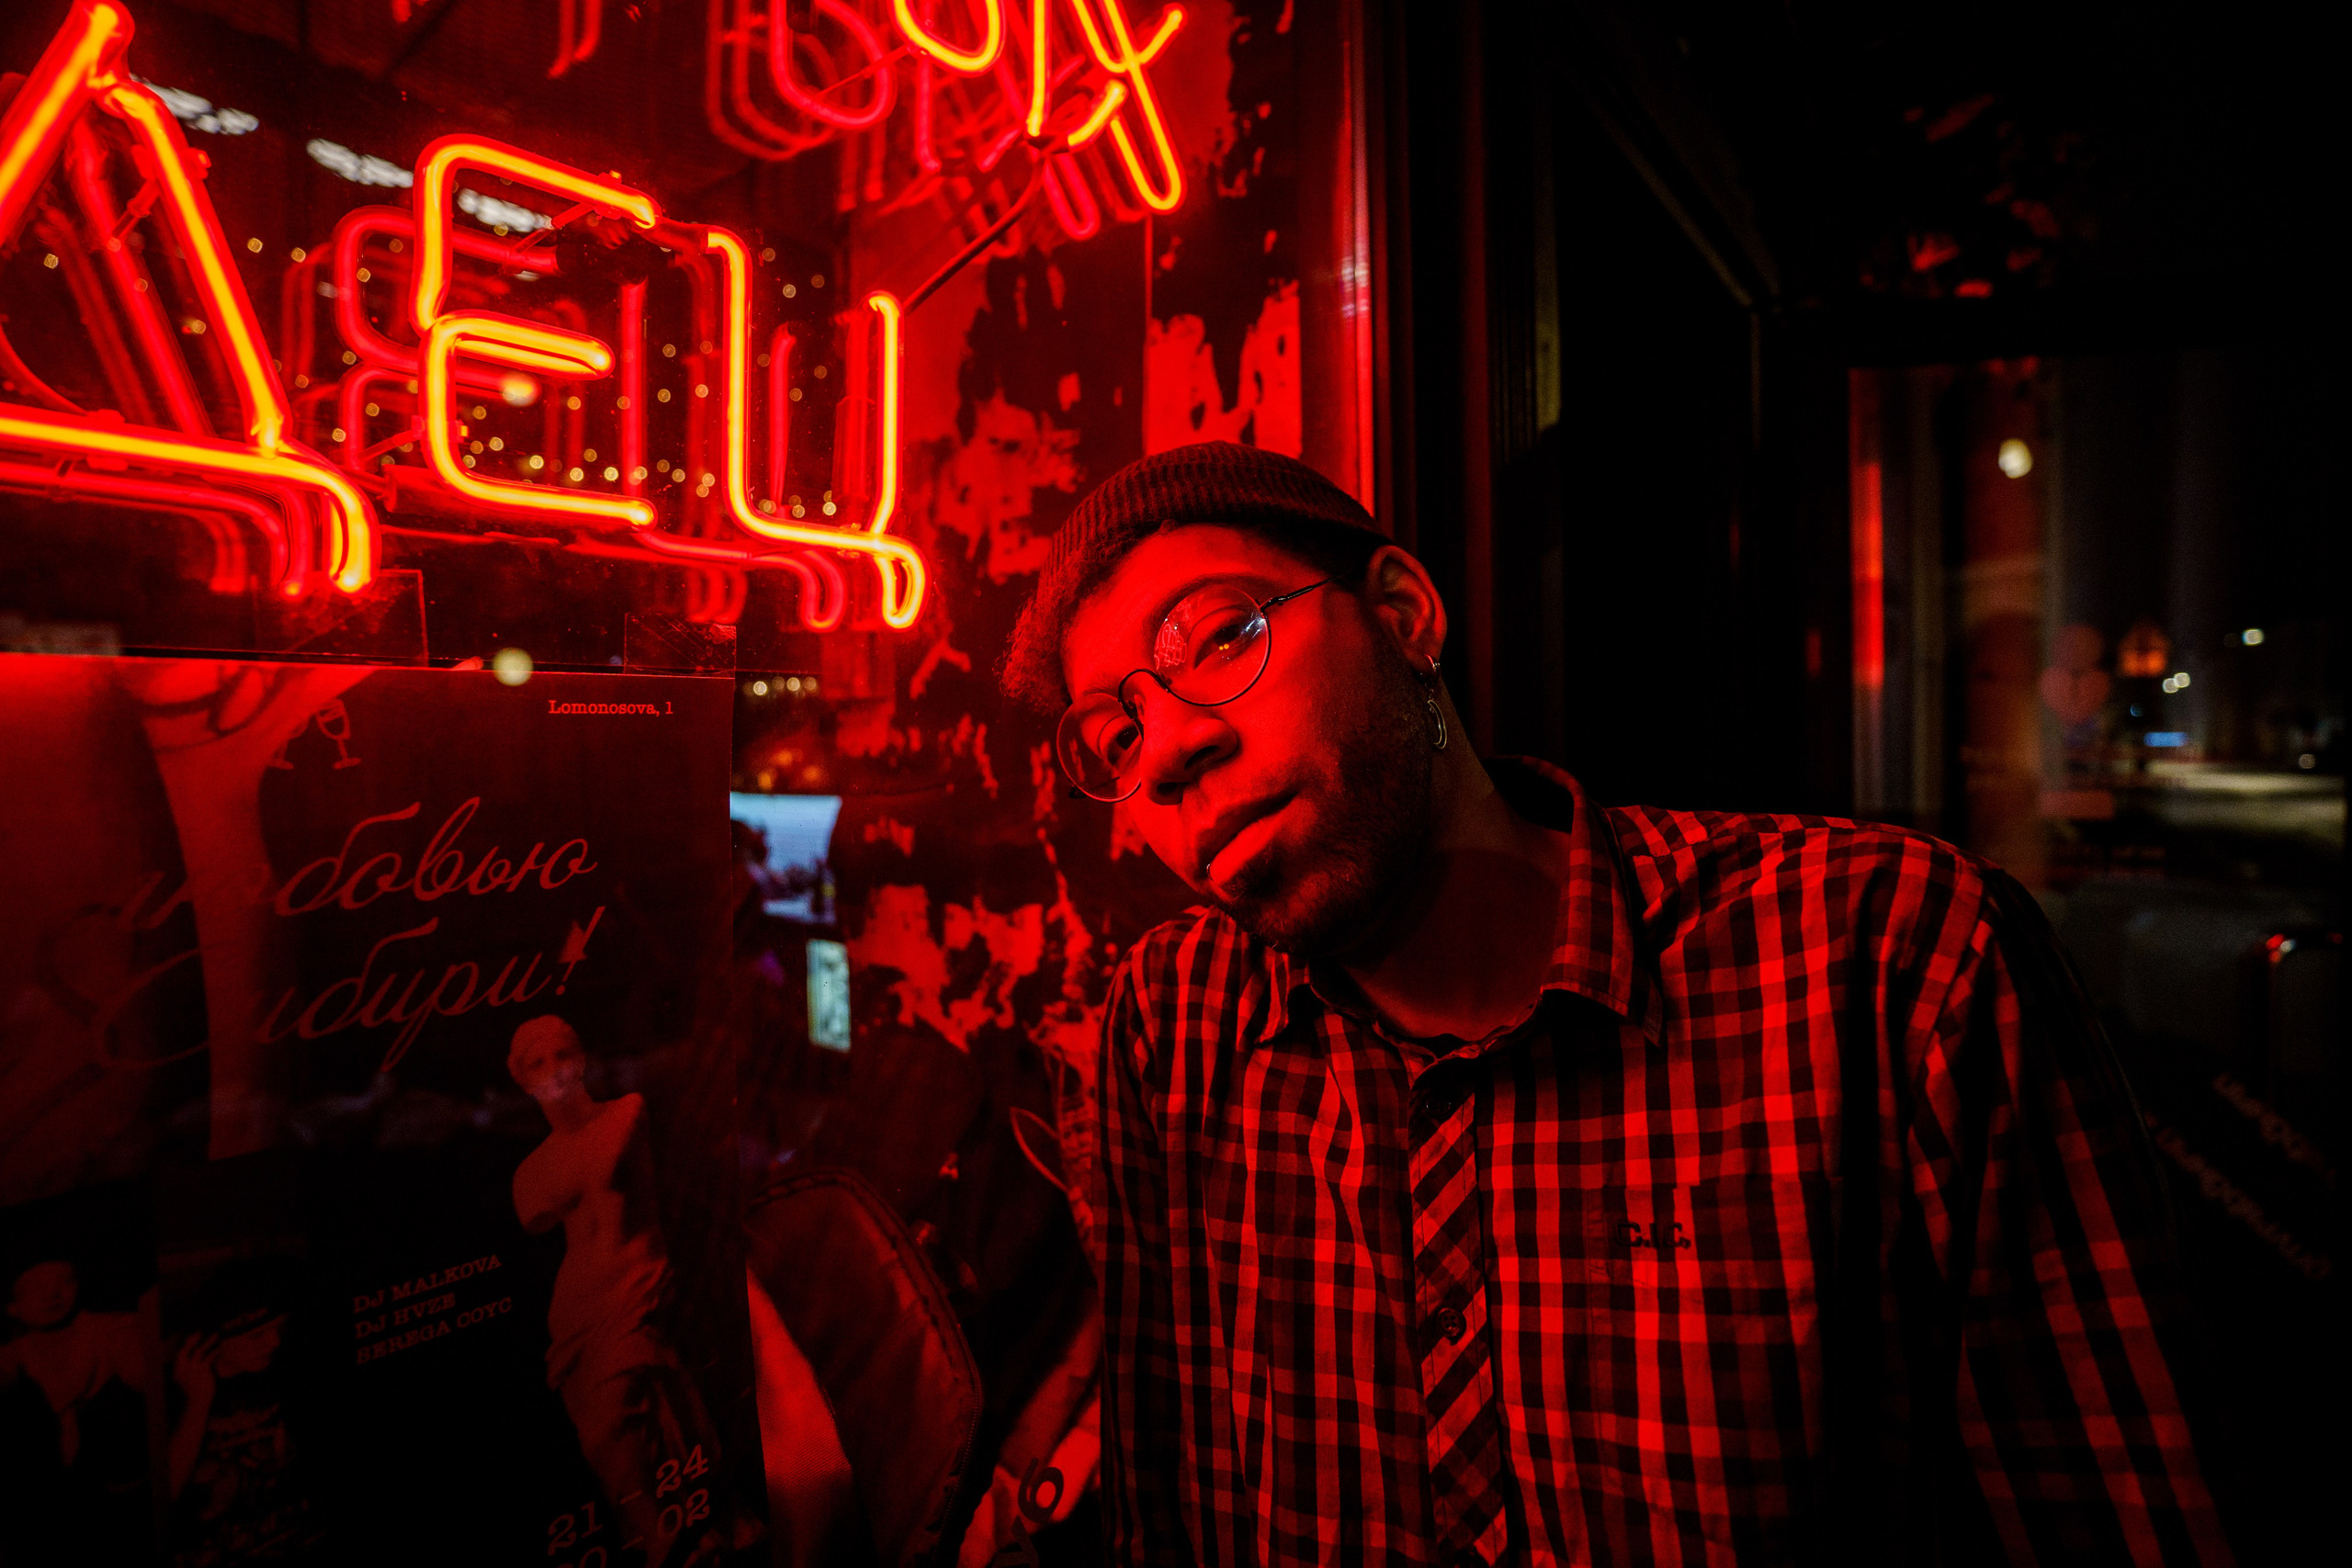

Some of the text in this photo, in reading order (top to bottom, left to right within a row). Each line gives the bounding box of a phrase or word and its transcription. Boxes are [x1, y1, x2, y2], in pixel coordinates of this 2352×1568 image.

[548, 700, 674, 717] Lomonosova, 1
[115, 796, 598, 930] бовью
[352, 1254, 503, 1314] DJ MALKOVA
[354, 1314, 388, 1339] DJ
[356, 1320, 453, 1366] SEREGA
[548, 1500, 603, 1558] 21
[655, 1443, 710, 1499] 24
[657, 1487, 712, 1539] 02
